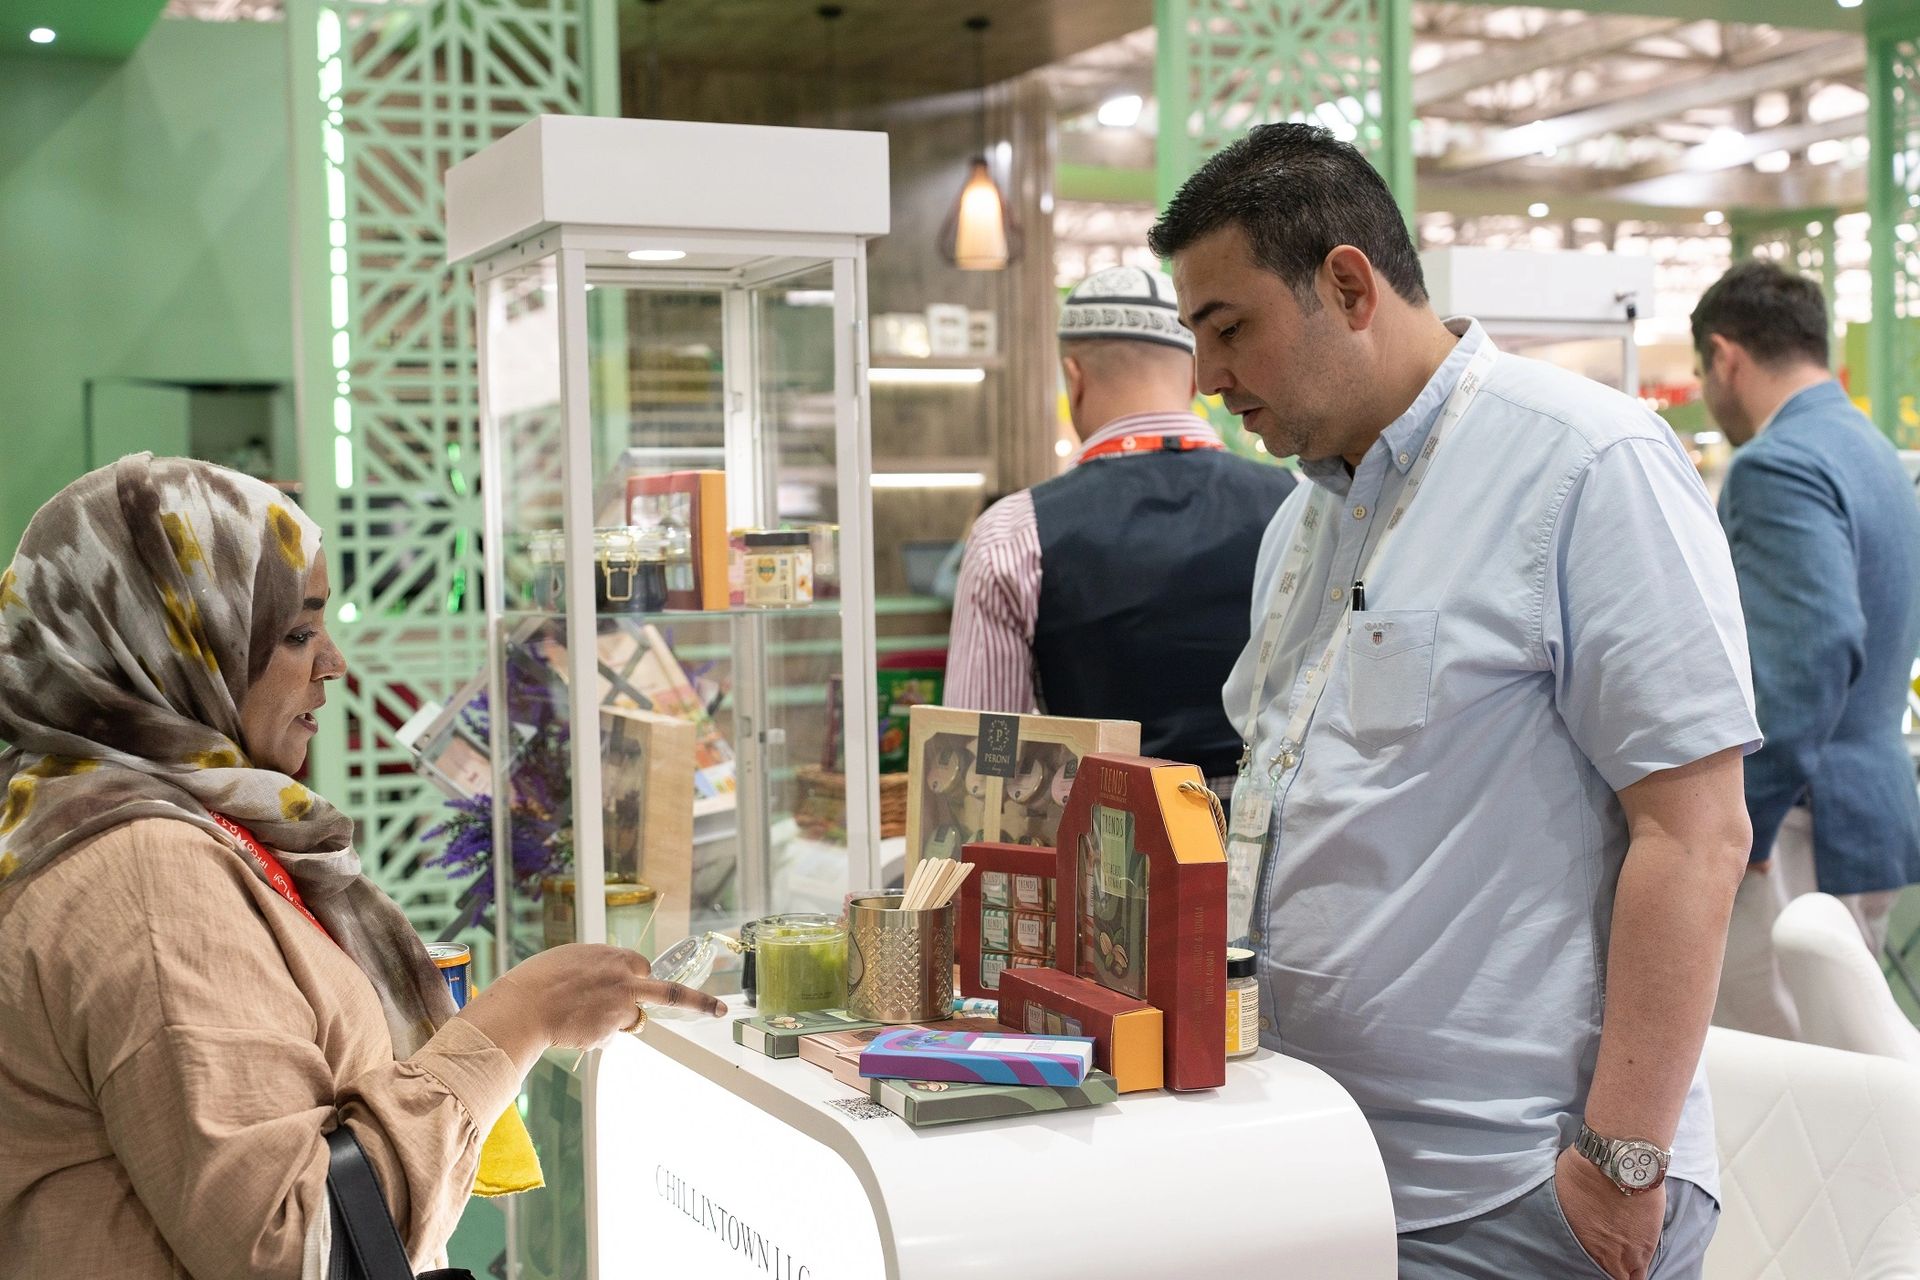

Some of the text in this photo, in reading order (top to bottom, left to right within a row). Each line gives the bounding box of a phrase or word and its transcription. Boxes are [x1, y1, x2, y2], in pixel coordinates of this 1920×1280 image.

[1364, 622, 1395, 631] GANT
[996, 729, 1004, 742] P
[984, 752, 1011, 765] PERONI
[1100, 766, 1129, 797] TRENDS
[1102, 813, 1124, 838] TRENDS
[247, 843, 269, 870] IFFCO
[1017, 879, 1036, 890] TRENDS
[984, 918, 1003, 930] TRENDS
[1020, 923, 1038, 935] TRENDS
[655, 1164, 769, 1273] CHILLINTOWN
